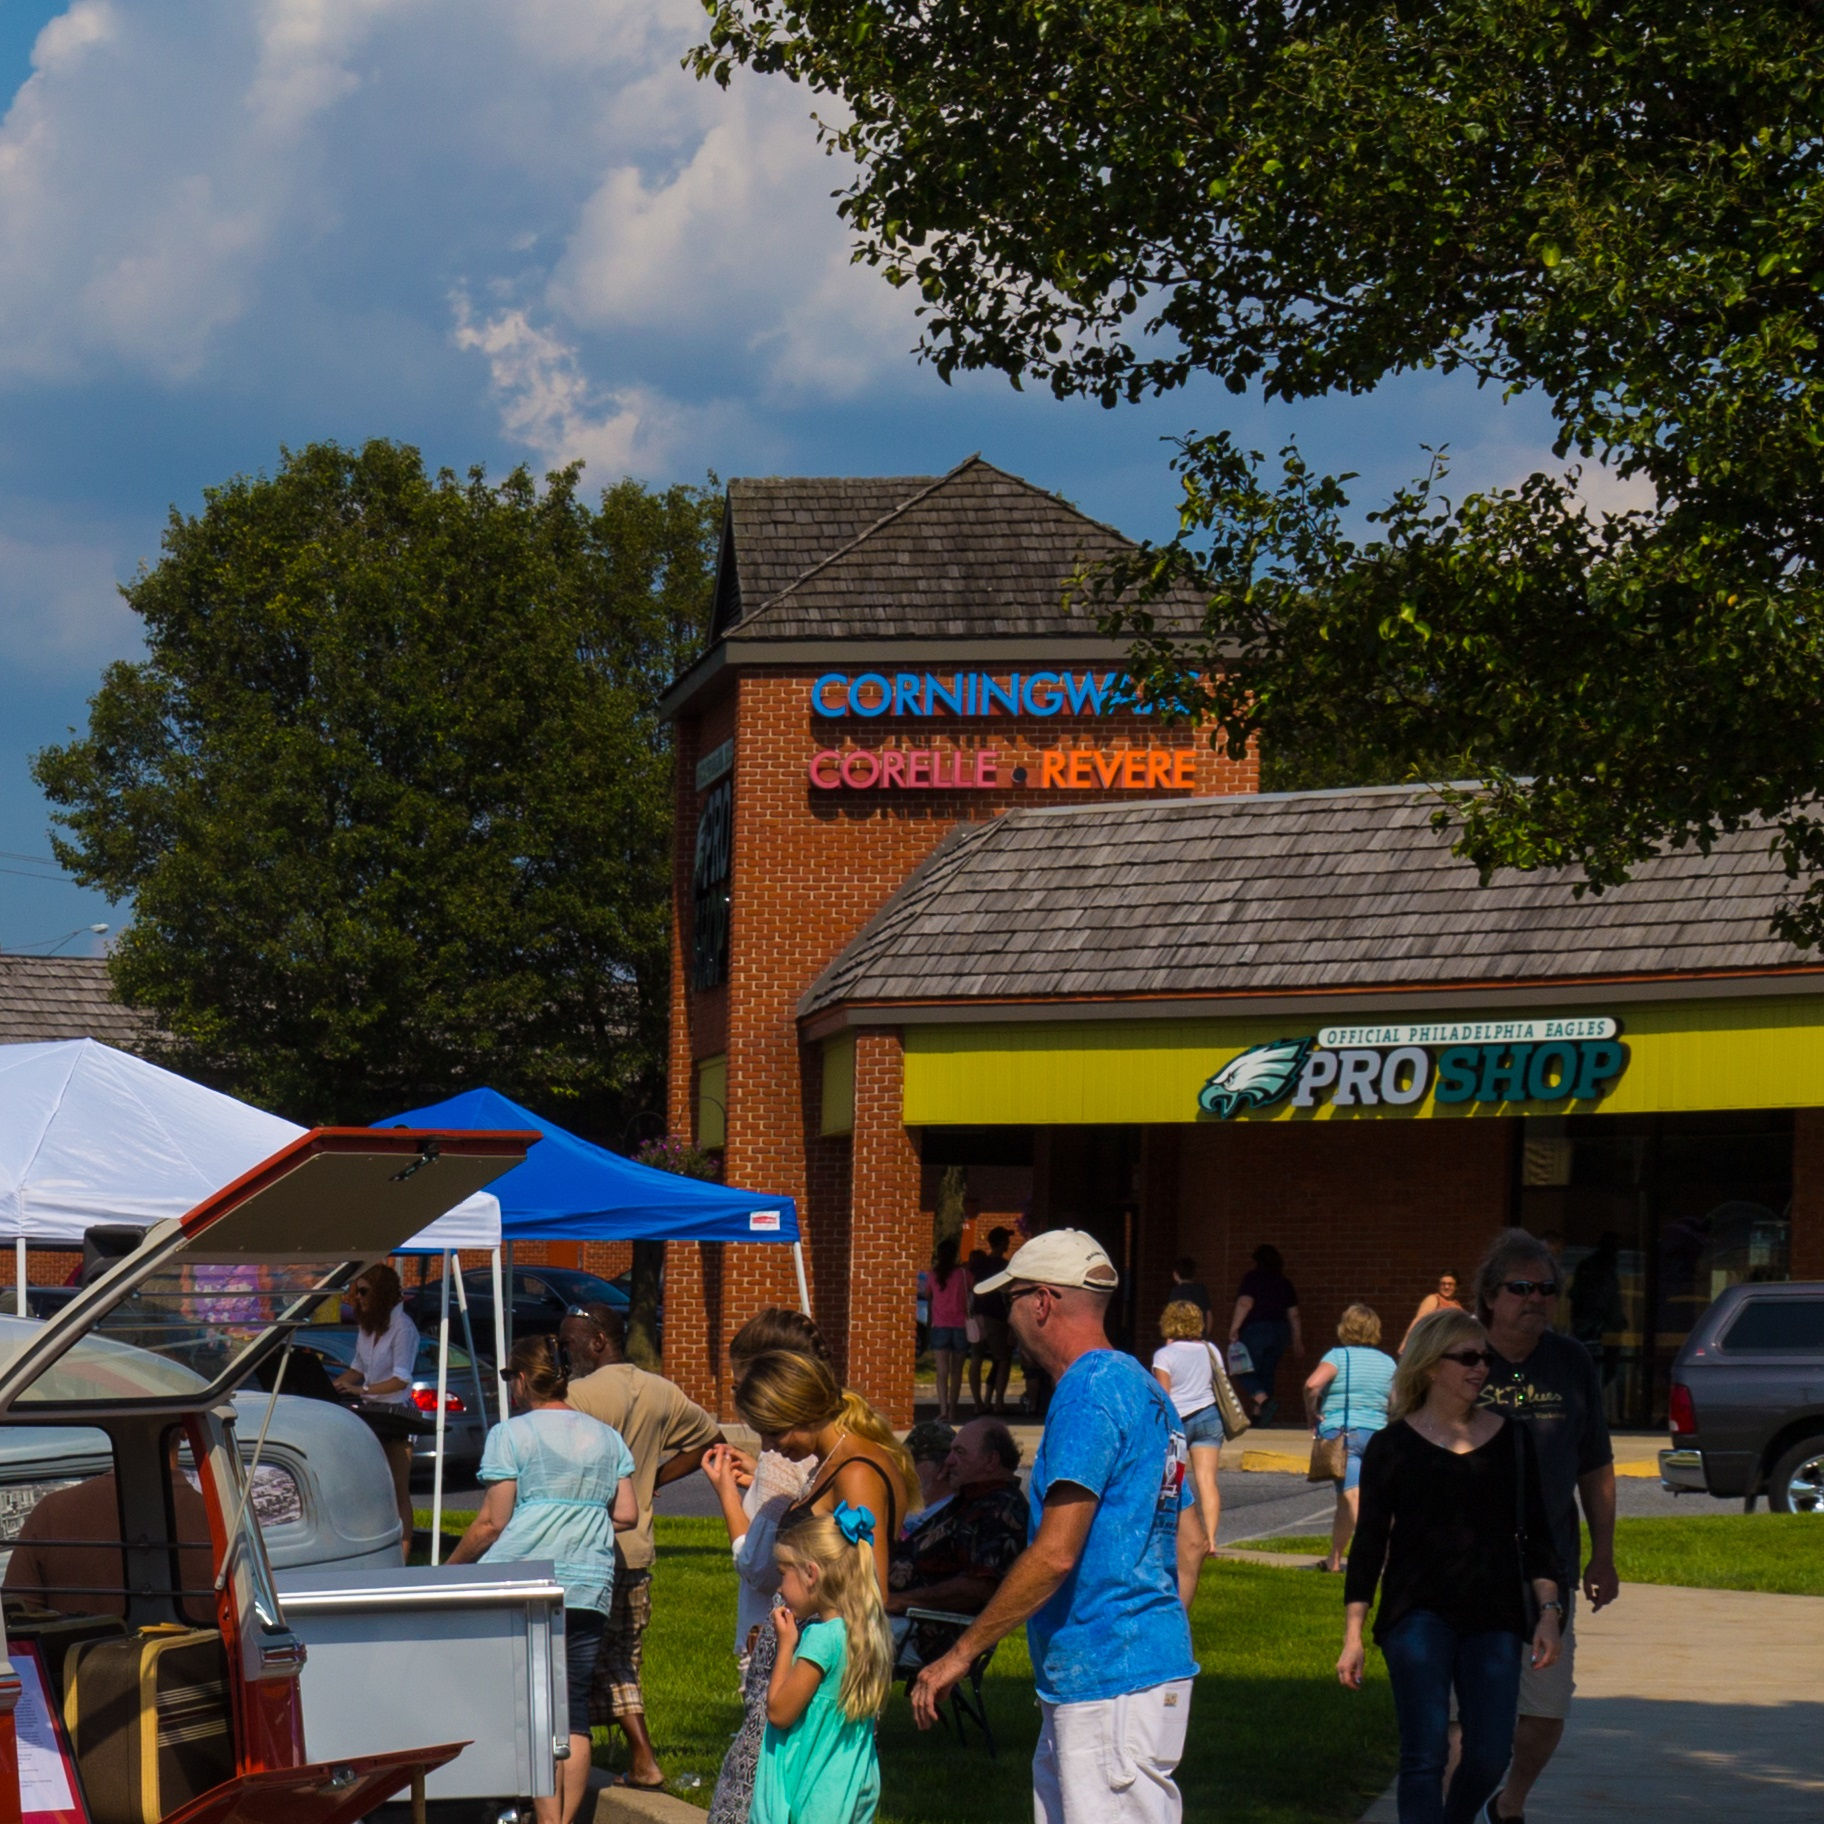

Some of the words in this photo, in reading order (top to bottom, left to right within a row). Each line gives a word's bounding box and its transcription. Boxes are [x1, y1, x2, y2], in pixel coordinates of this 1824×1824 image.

[809, 750, 998, 789] CORELLE
[1041, 749, 1197, 789] REVERE
[1326, 1028, 1400, 1045] OFFICIAL
[1409, 1023, 1535, 1042] PHILADELPHIA
[1544, 1020, 1606, 1038] EAGLES
[1292, 1046, 1429, 1107] PRO
[1435, 1041, 1623, 1103] SHOP
